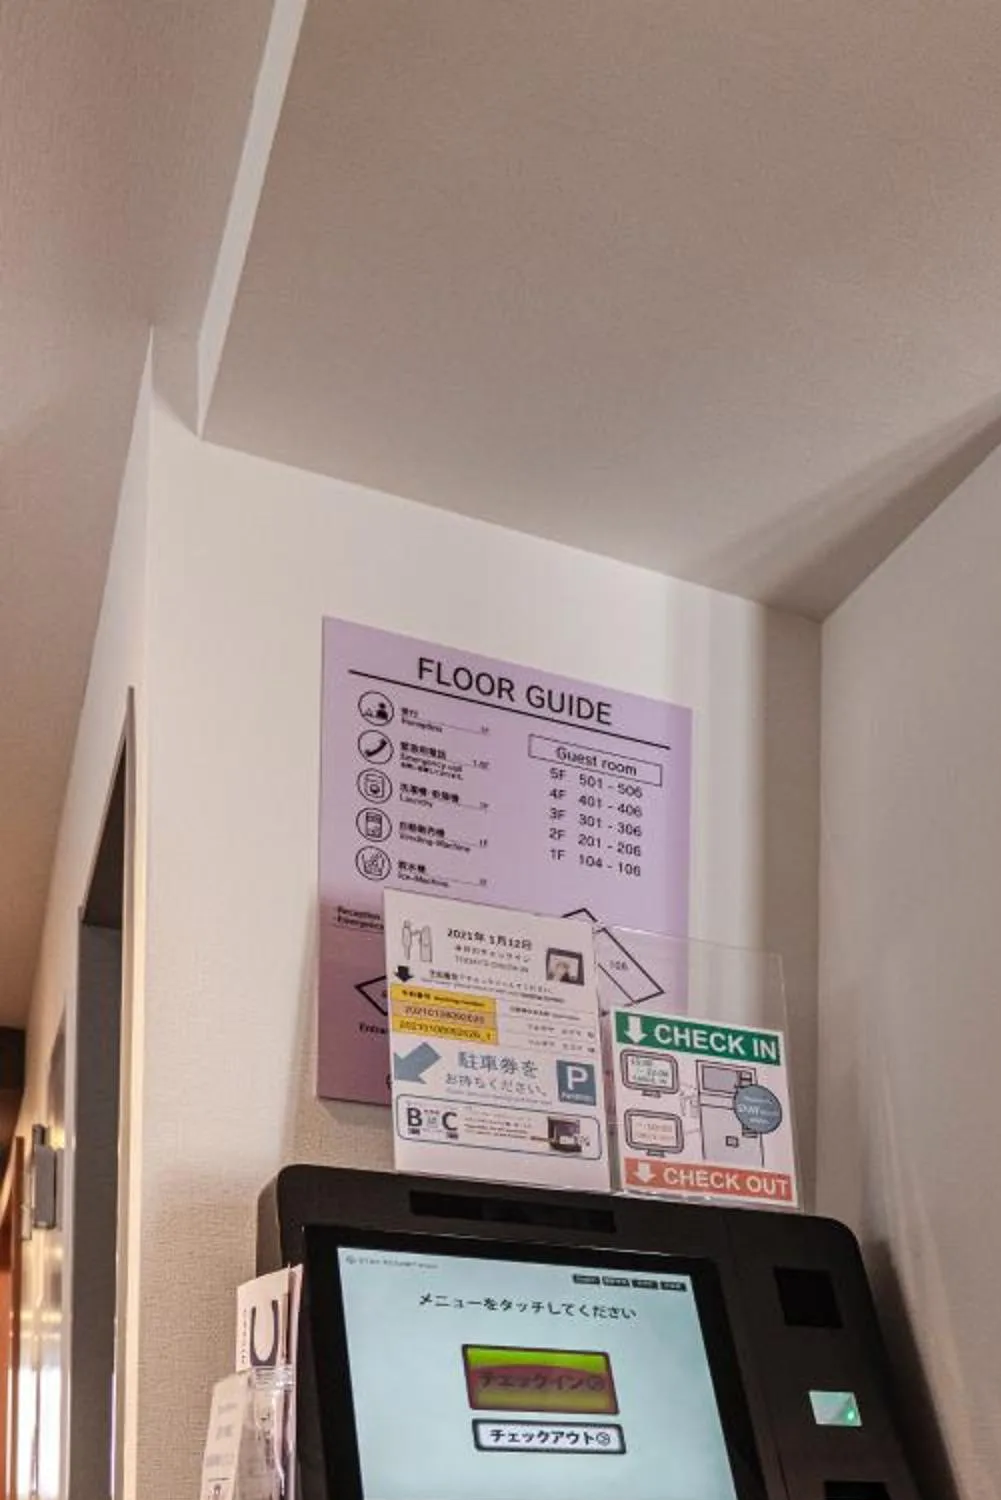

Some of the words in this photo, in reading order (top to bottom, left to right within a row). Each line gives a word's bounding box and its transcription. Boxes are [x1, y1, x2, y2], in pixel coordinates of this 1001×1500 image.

[417, 656, 516, 703] FLOOR
[525, 684, 613, 727] GUIDE
[555, 746, 598, 767] Guest
[601, 760, 638, 777] room
[549, 767, 566, 781] 5F
[579, 773, 603, 789] 501
[617, 783, 643, 799] 506
[549, 788, 567, 800] 4F
[578, 795, 602, 809] 401
[617, 803, 643, 818] 406
[549, 807, 566, 820] 3F
[579, 813, 602, 828] 301
[617, 822, 642, 837] 306
[549, 827, 566, 840] 2F
[578, 833, 602, 848] 201
[617, 842, 642, 857] 206
[550, 848, 565, 860] 1F
[618, 861, 641, 877] 106
[654, 1023, 746, 1056] CHECK
[753, 1038, 777, 1060] IN
[458, 1051, 538, 1079] 駐車券を
[566, 1066, 588, 1091] P
[407, 1106, 423, 1127] B
[441, 1111, 458, 1131] C
[663, 1167, 741, 1190] CHECK
[746, 1175, 789, 1196] OUT
[418, 1292, 637, 1321] メニューをタッチしてください
[489, 1428, 595, 1446] チェックアウト
